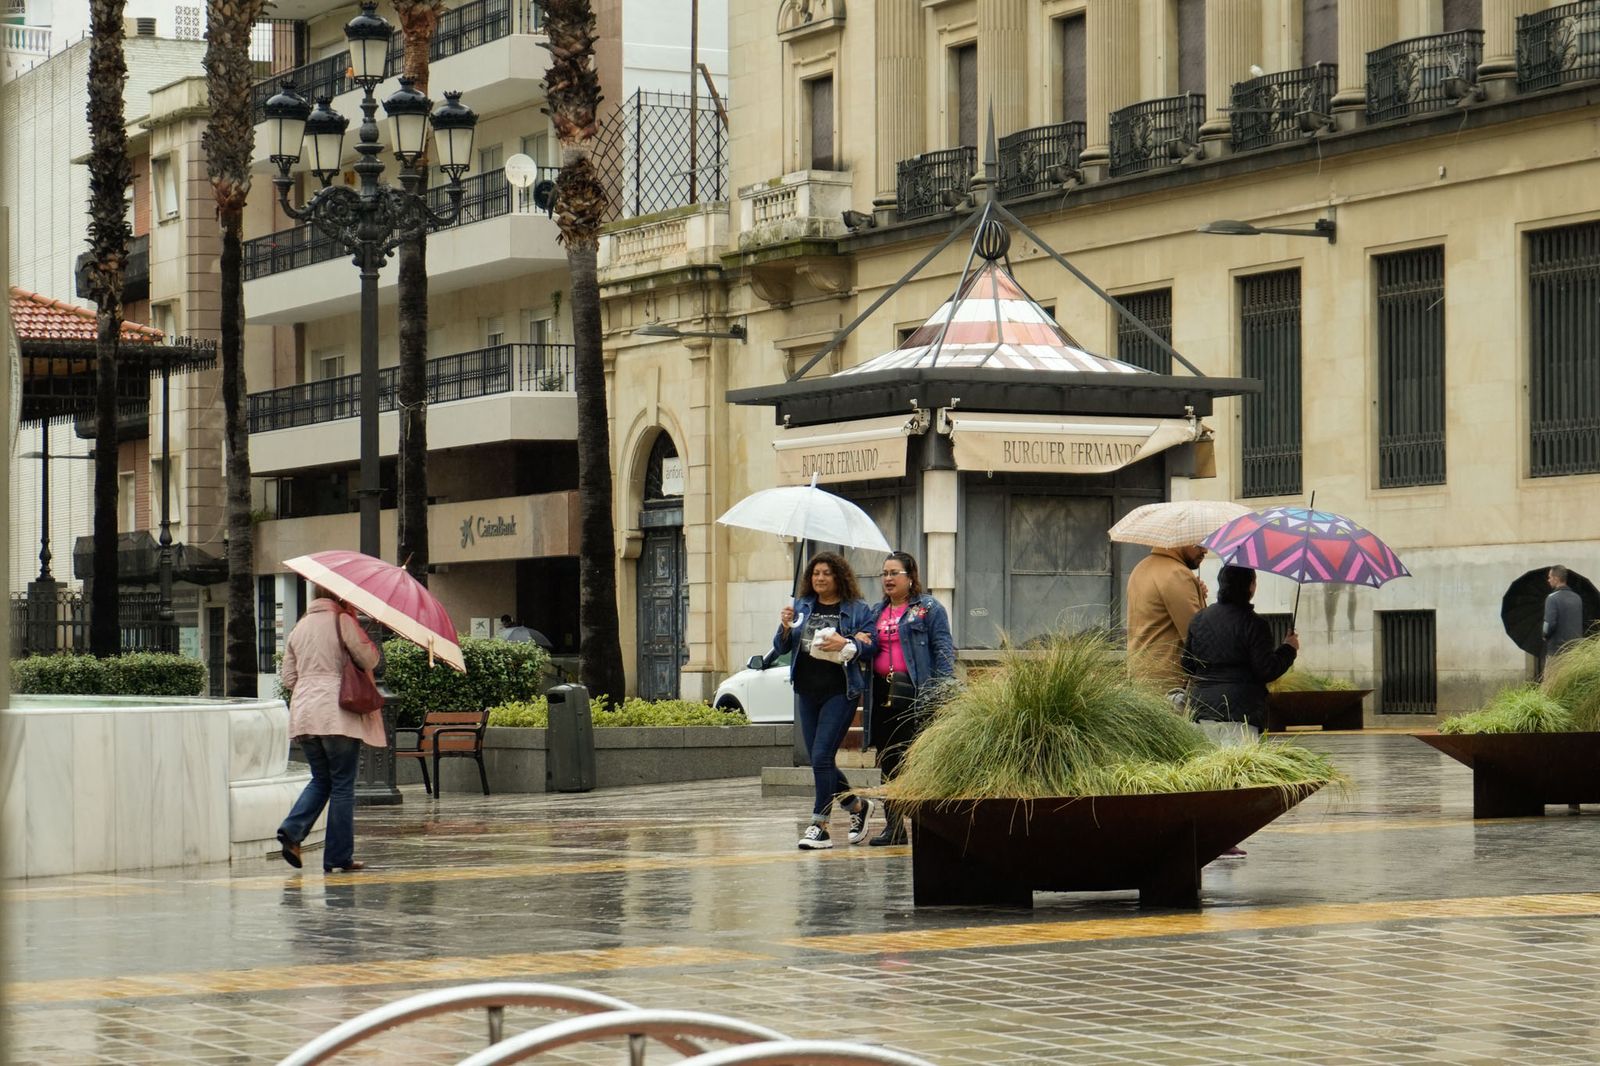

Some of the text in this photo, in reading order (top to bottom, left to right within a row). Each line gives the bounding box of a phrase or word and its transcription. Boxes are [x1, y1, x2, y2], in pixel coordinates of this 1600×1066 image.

[802, 448, 879, 477] BURGUER FERNANDO
[1003, 440, 1065, 465] BURGUER
